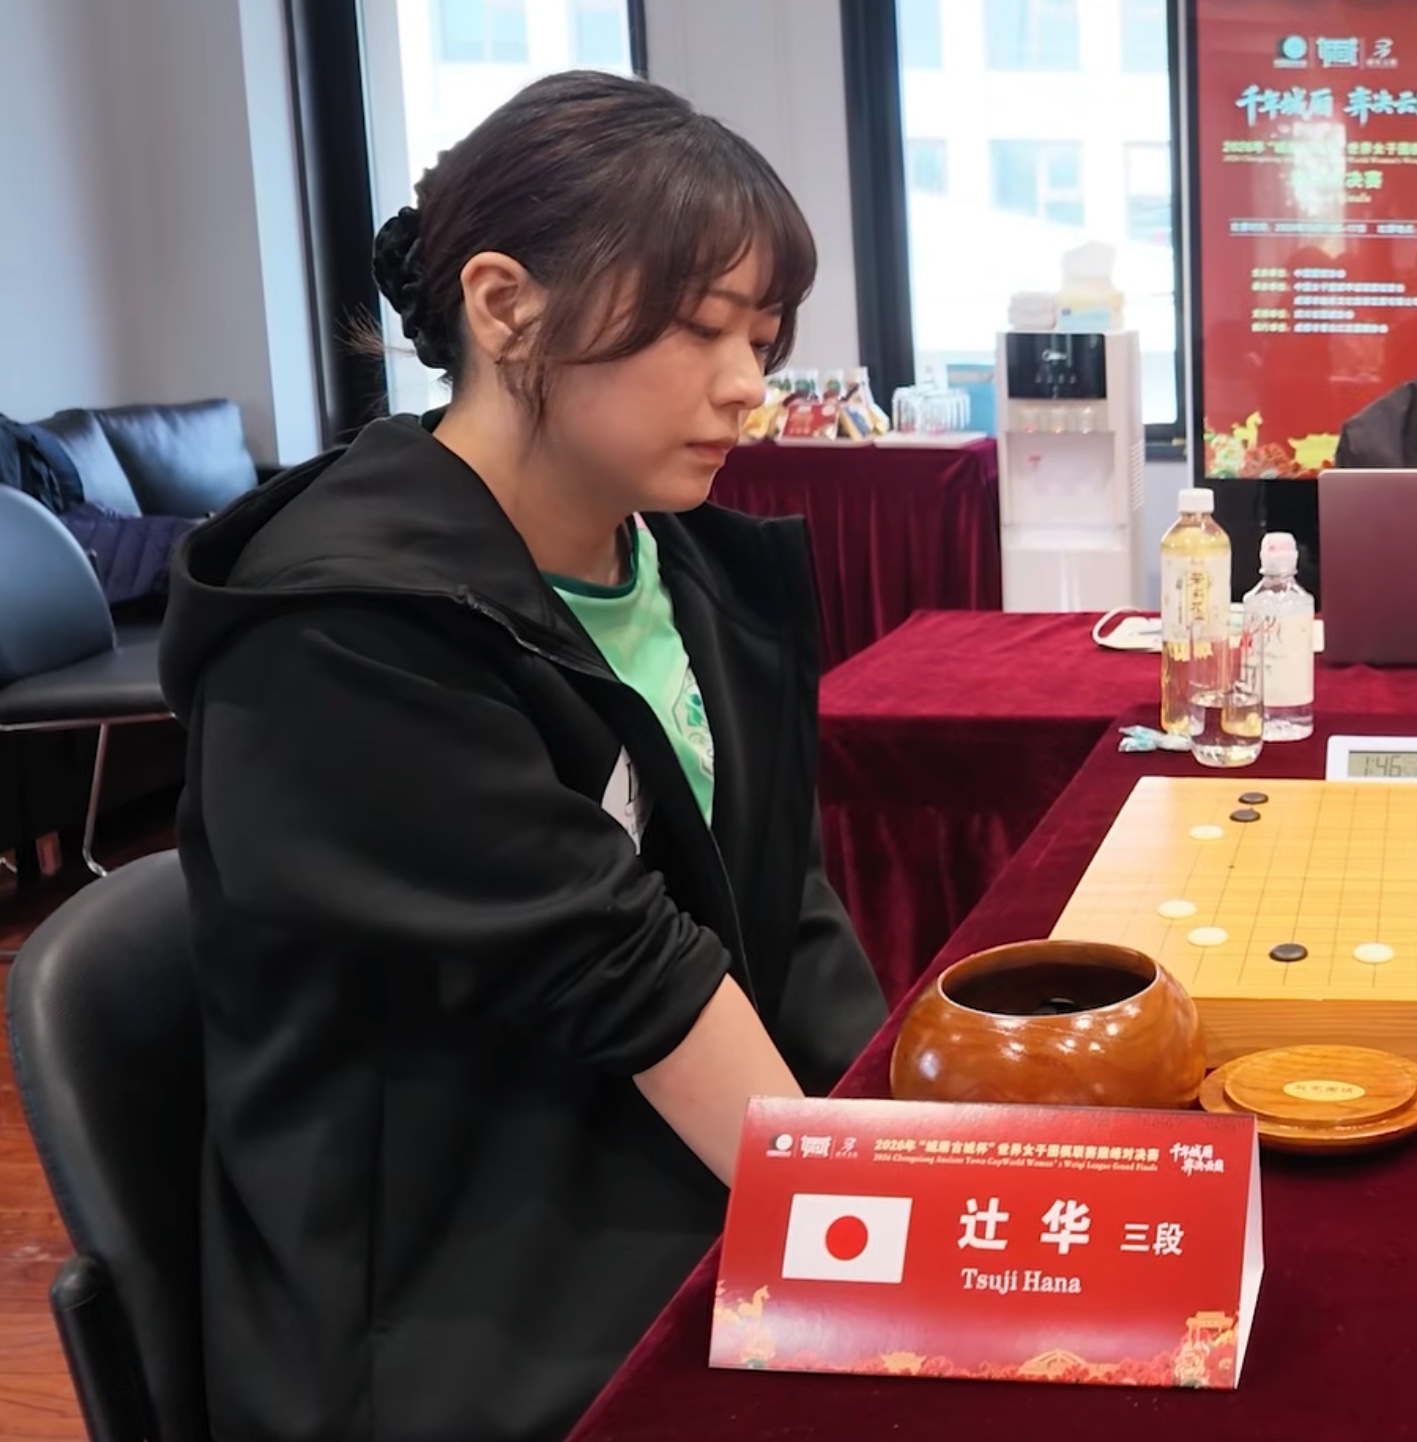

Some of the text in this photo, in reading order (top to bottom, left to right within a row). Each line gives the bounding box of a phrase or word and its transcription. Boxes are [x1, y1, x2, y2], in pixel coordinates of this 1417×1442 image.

[1364, 755, 1402, 777] 1:46
[1120, 1222, 1184, 1256] 三段
[961, 1268, 1082, 1295] Tsuji Hana
